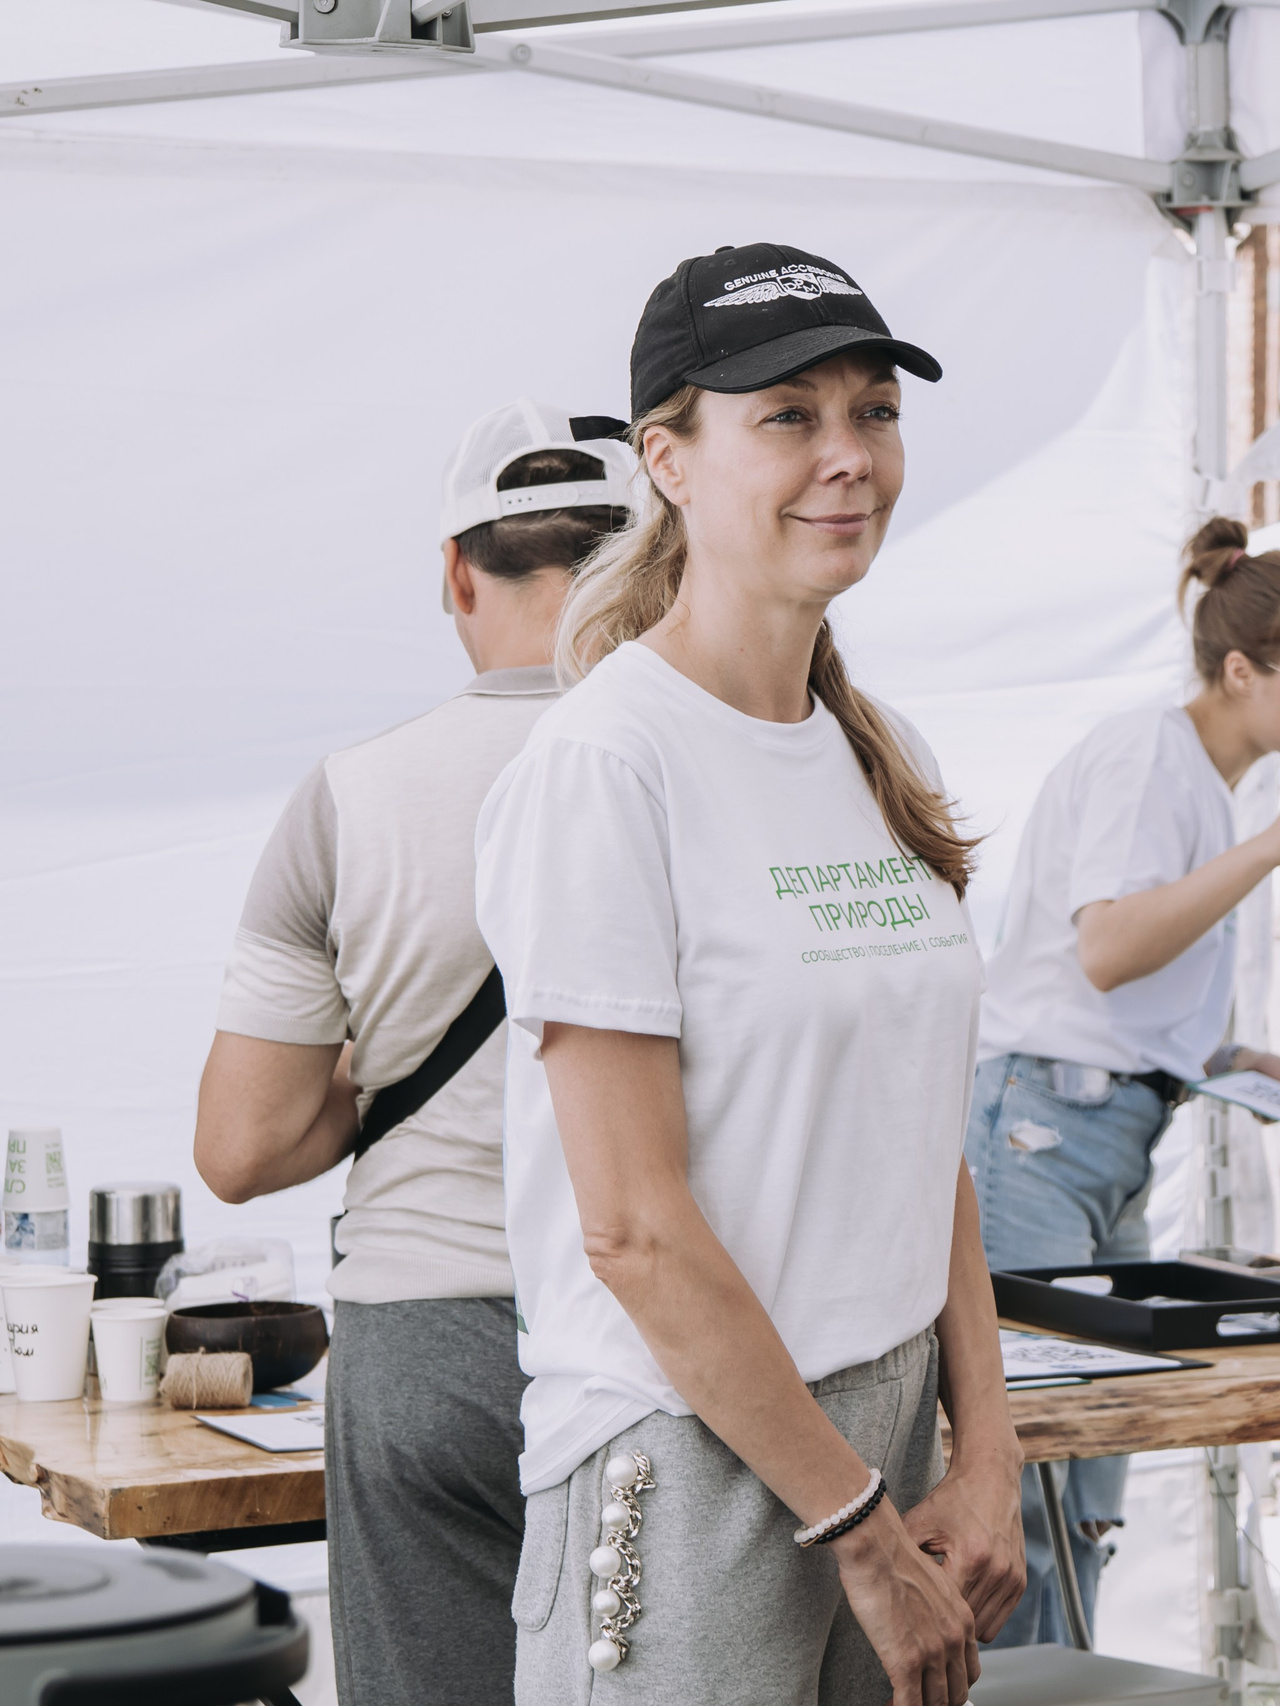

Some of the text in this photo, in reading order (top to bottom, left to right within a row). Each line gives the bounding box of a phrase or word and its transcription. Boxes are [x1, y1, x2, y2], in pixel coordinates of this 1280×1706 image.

[724, 269, 778, 291] GENUINE
[769, 855, 932, 900] ДЕПАРТАМЕНТ
[808, 893, 932, 932] ПРИРОДЫ
[801, 933, 969, 964] СООБЩЕСТВО ПОСЕЛЕНИЕ СОБЫТИЯ
